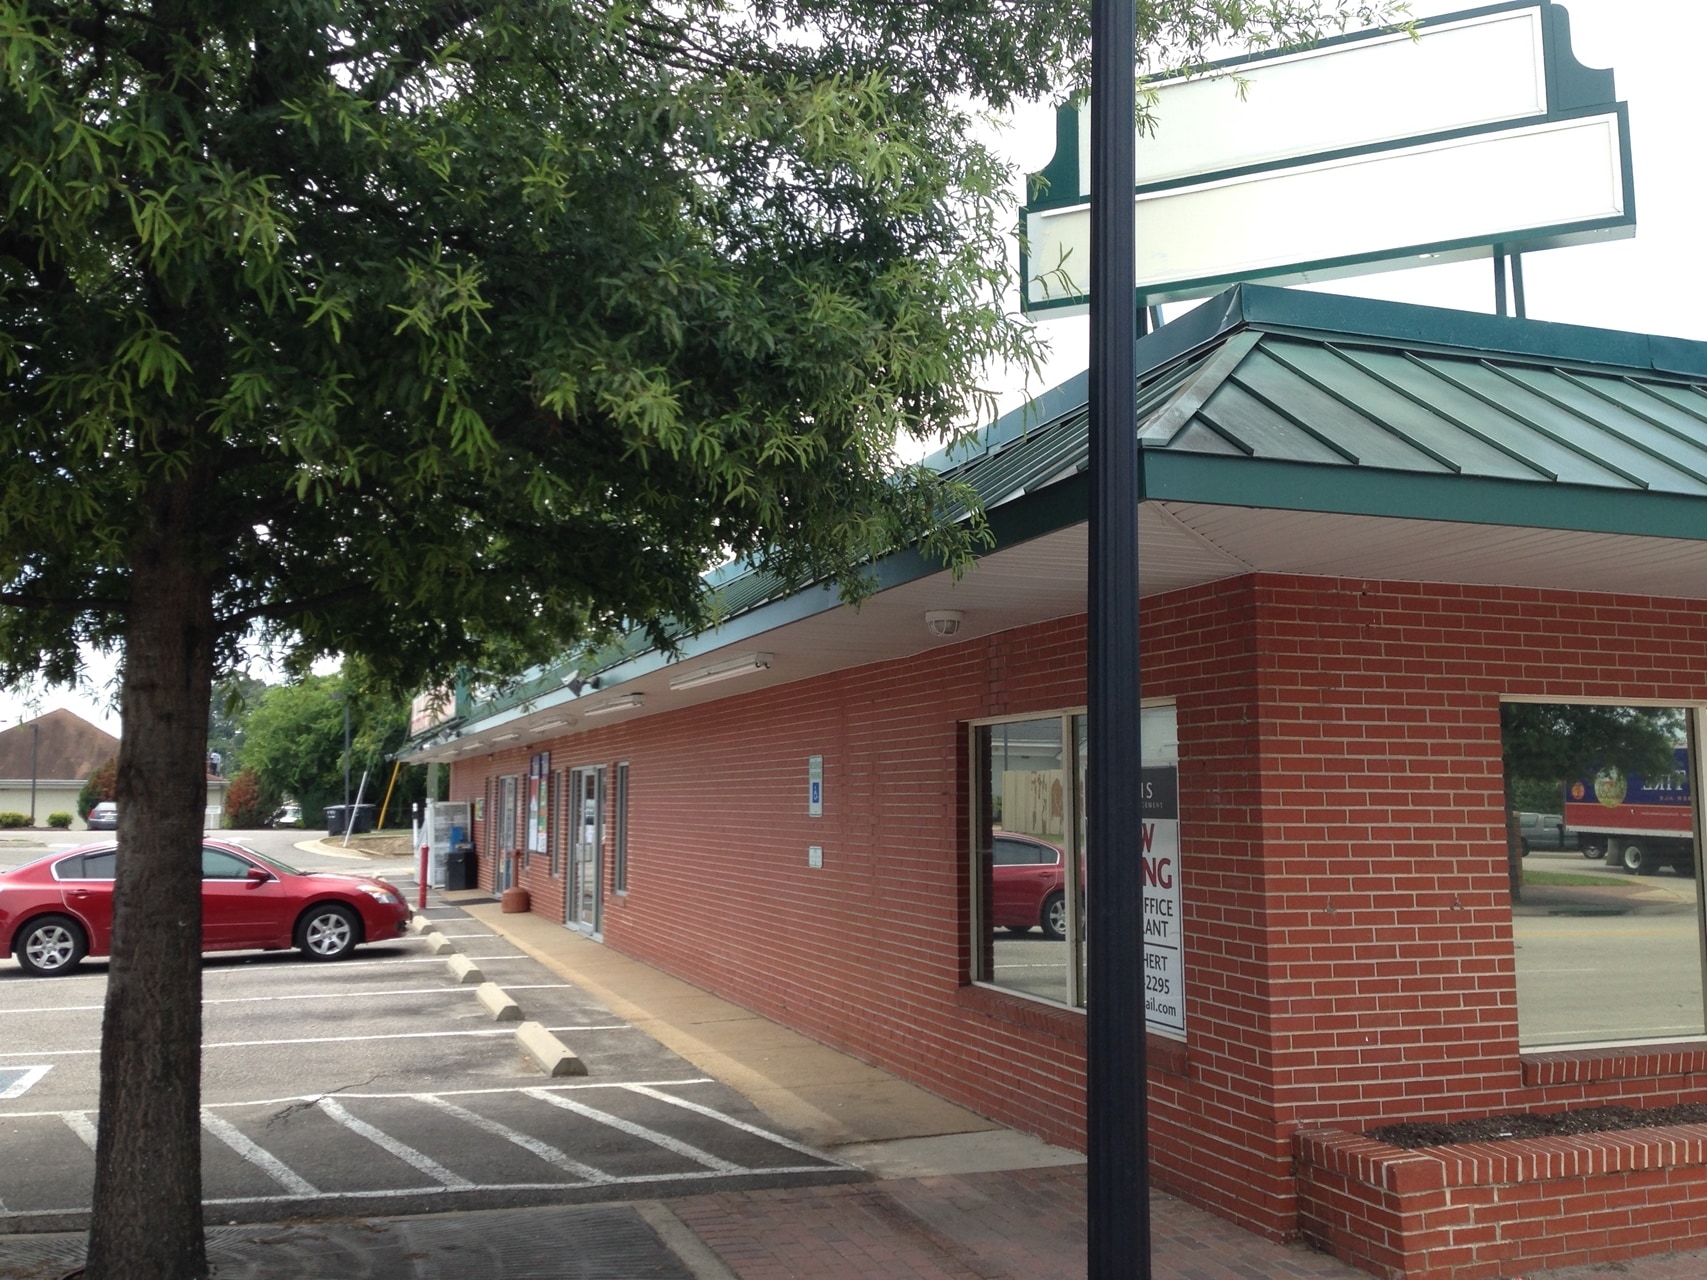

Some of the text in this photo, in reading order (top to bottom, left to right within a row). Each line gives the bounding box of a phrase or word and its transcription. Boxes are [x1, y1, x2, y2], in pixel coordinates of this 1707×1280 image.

[1141, 857, 1173, 889] NG
[1144, 918, 1169, 938] ANT
[1145, 975, 1170, 994] 2295
